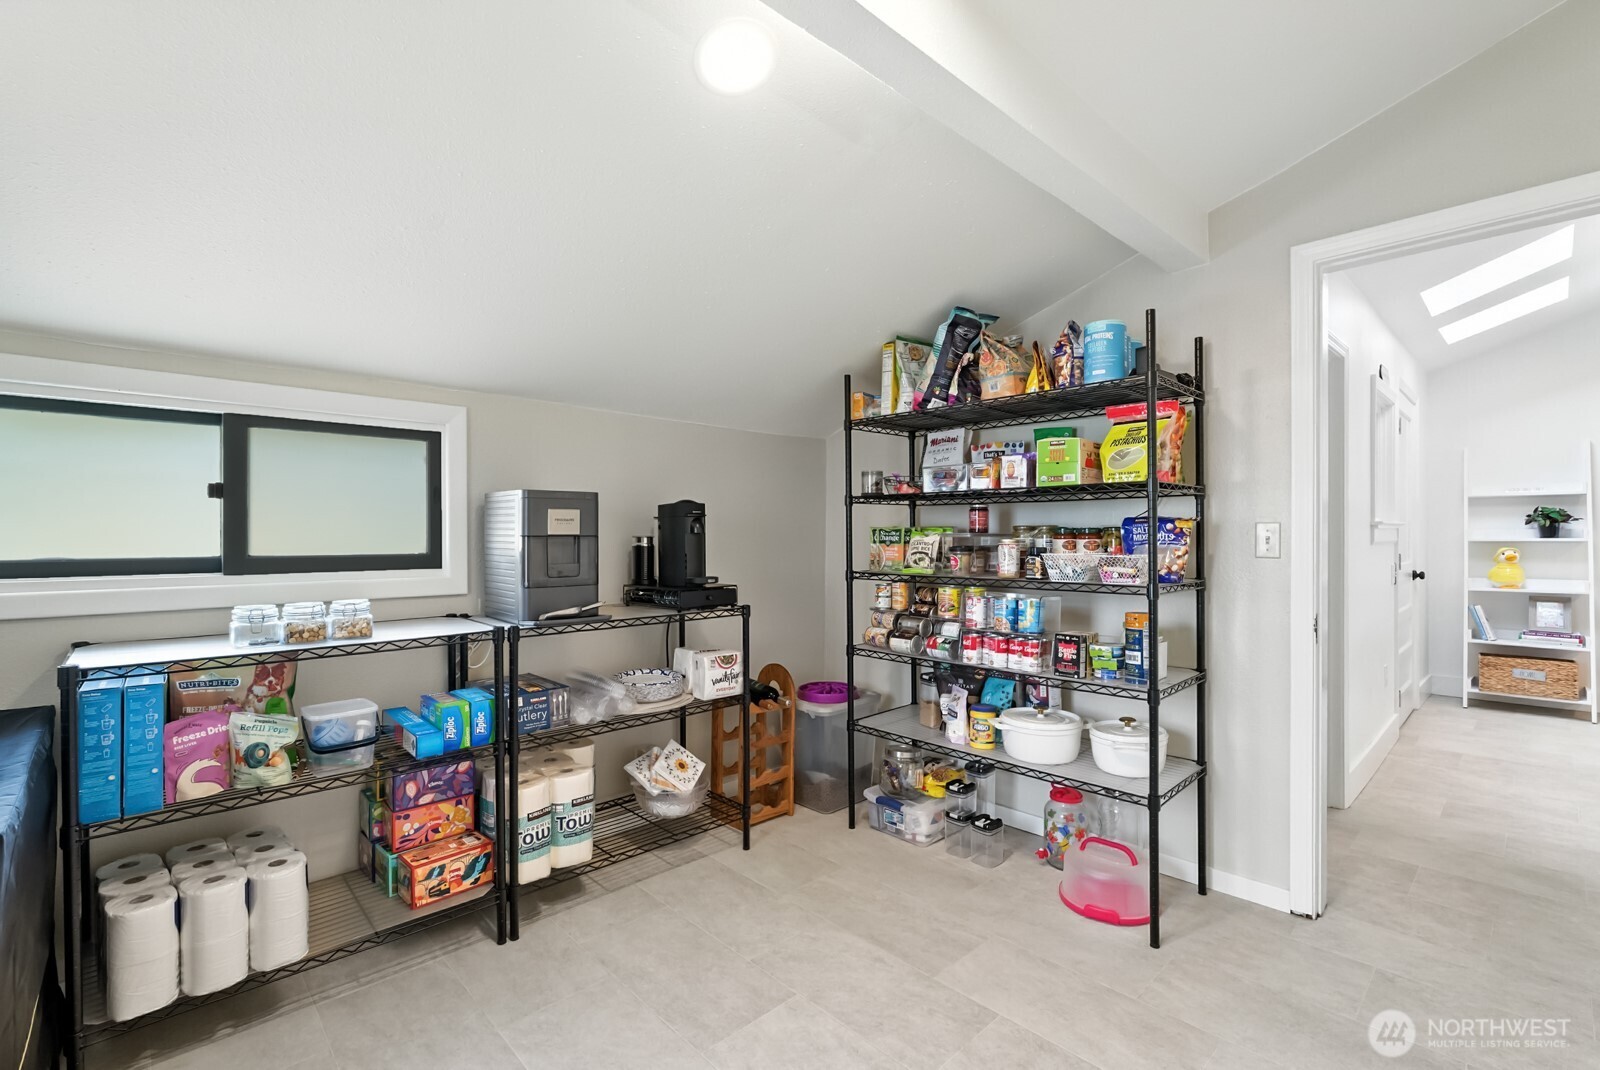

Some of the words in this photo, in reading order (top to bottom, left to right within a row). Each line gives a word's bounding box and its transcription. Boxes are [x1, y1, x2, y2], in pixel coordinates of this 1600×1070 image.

[1092, 331, 1114, 340] PROTEINS
[930, 435, 958, 447] Mariani
[1132, 526, 1149, 535] SALT
[518, 704, 534, 713] rystal
[476, 711, 487, 734] Ziploc
[517, 710, 548, 723] utlery
[240, 724, 266, 732] Refill
[267, 725, 289, 735] Pops
[446, 716, 457, 739] Ziploc
[172, 730, 207, 745] Freeze
